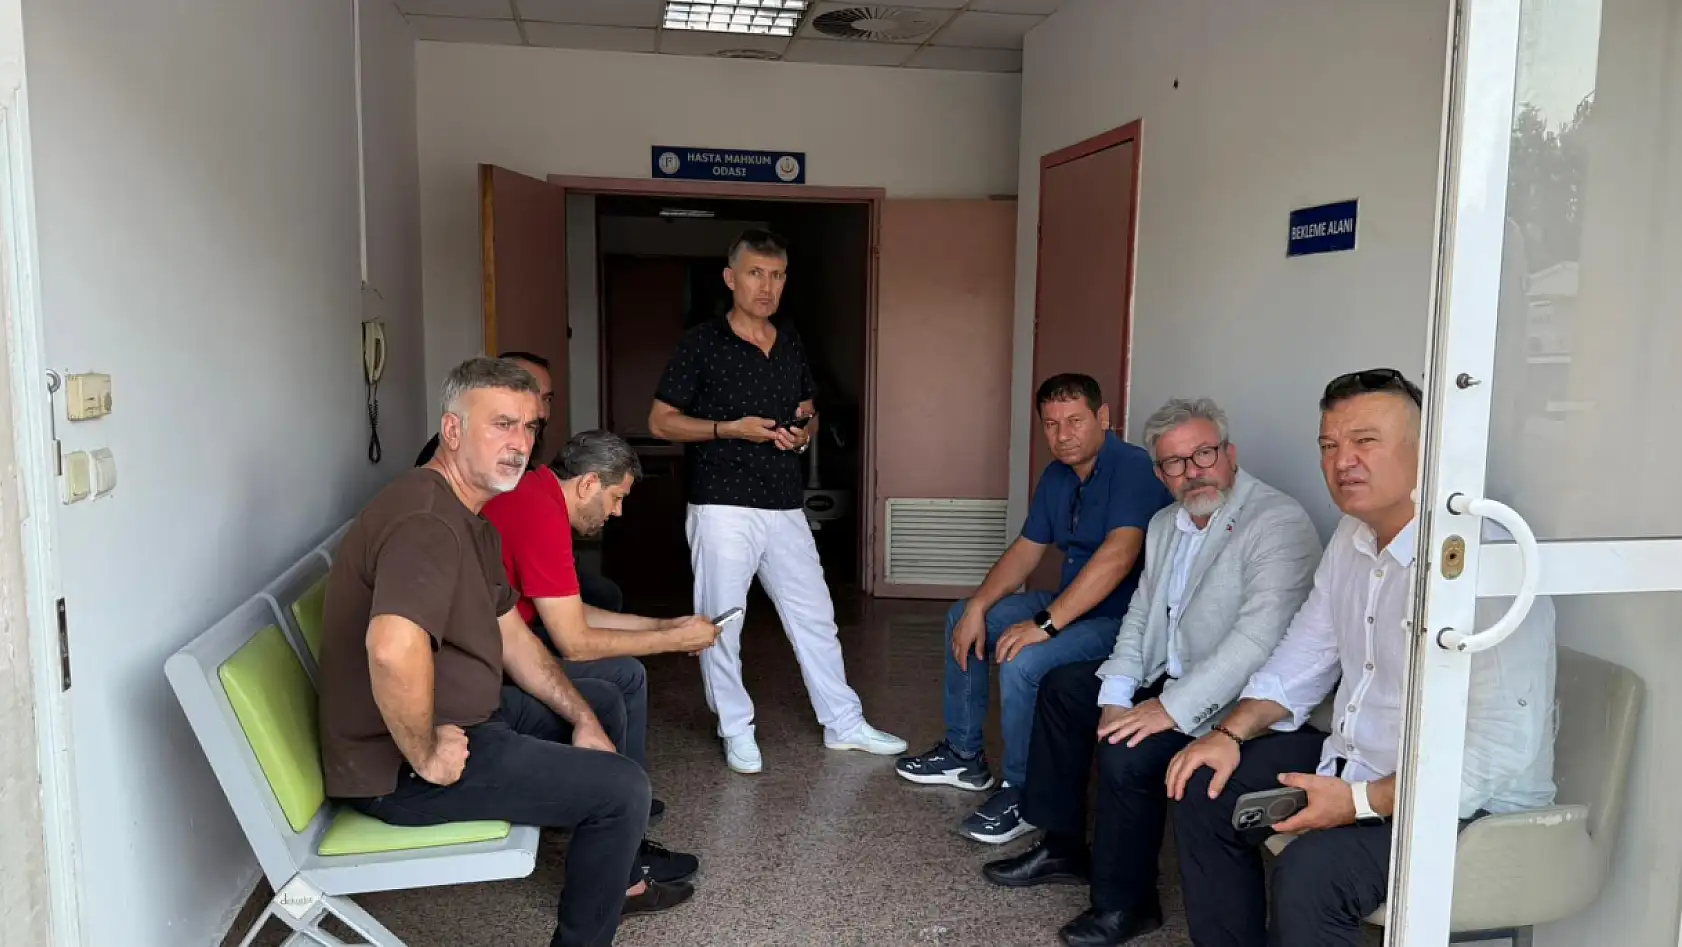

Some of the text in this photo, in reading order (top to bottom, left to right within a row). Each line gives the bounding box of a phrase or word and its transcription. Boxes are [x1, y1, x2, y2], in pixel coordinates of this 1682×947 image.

[687, 152, 772, 165] HASTA MAHKUM
[712, 166, 747, 177] ODASI
[1292, 218, 1353, 240] BEKLEME ALANI
